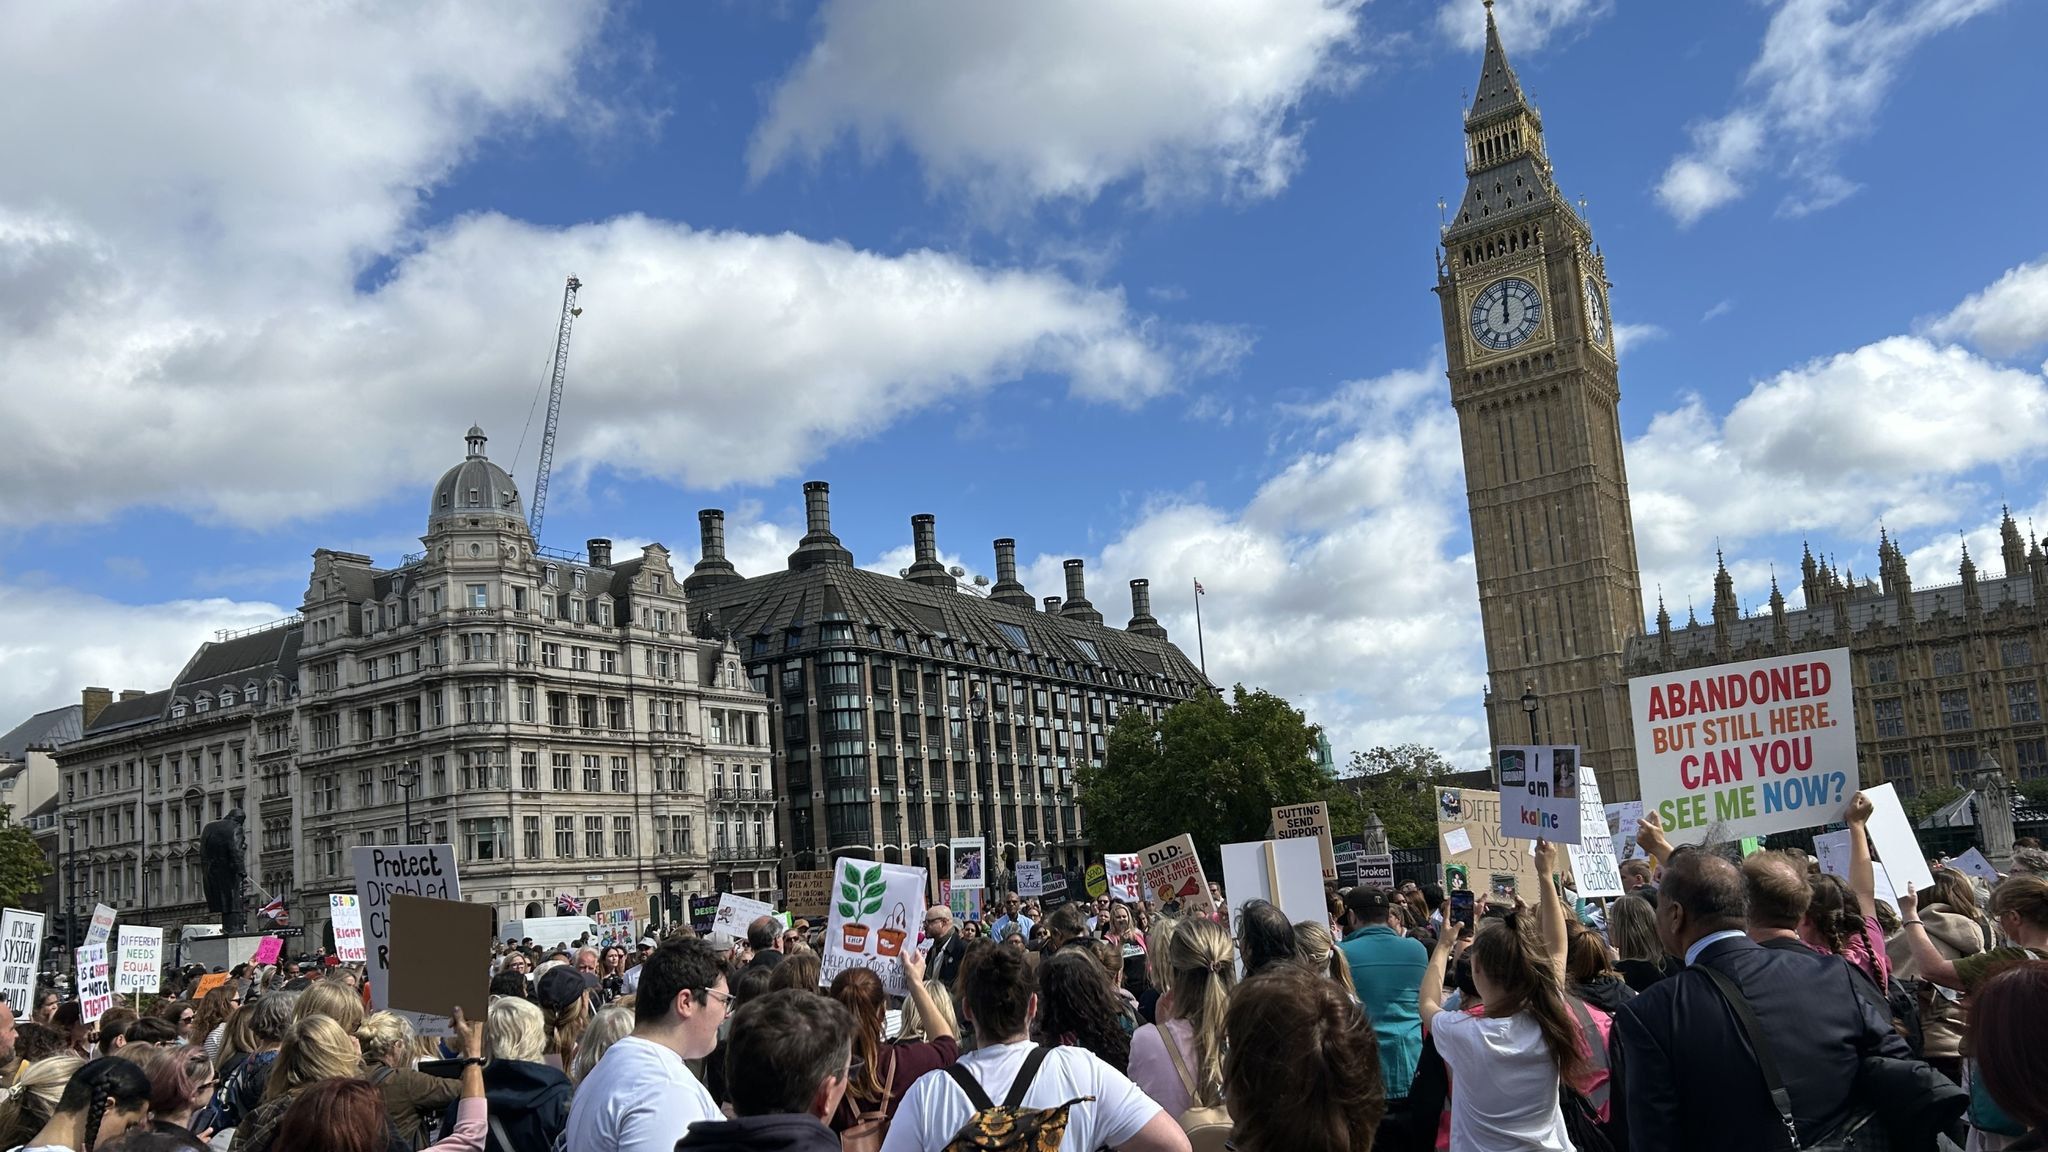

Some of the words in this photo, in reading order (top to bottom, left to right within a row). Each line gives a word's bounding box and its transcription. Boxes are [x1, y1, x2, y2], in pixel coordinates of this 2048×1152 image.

[1649, 661, 1832, 721] ABANDONED
[1652, 722, 1696, 754] BUT
[1703, 712, 1764, 745] STILL
[1770, 702, 1837, 735] HERE.
[1535, 753, 1538, 772] I
[1680, 747, 1742, 790] CAN
[1750, 736, 1813, 777] YOU
[1528, 780, 1549, 798] am
[1463, 800, 1501, 822] DIFFE
[1659, 794, 1707, 832] SEE
[1715, 786, 1756, 822] ME
[1763, 771, 1846, 814] NOW?
[1278, 805, 1320, 818] CUTTING
[1521, 805, 1558, 829] kaine
[1287, 817, 1313, 828] SEND
[1279, 826, 1324, 839] SUPPORT
[373, 849, 442, 877] Protect
[1148, 845, 1182, 865] DLD:
[1478, 849, 1524, 872] LESS!
[1592, 855, 1611, 874] SEND
[1146, 866, 1170, 880] DON'T
[1172, 856, 1196, 870] MUTE
[1149, 878, 1167, 888] OUR
[1168, 865, 1200, 882] FUTURE
[1360, 866, 1390, 877] broken
[332, 896, 356, 906] SEND
[597, 908, 633, 925] FIGHTING
[12, 920, 24, 938] IT'S
[24, 922, 35, 940] THE
[336, 928, 362, 938] RIGHT
[121, 935, 160, 946] DIFFERENT
[847, 936, 862, 944] EHCP
[3, 939, 36, 964] SYSTEM
[126, 948, 154, 959] NEEDS
[338, 946, 367, 960] FIGHT
[124, 962, 154, 972] EQUAL
[824, 954, 844, 968] HELP
[845, 956, 862, 968] OUR
[866, 960, 884, 973] KIDS
[4, 966, 18, 984] NOT
[18, 966, 30, 984] THE
[120, 974, 157, 986] RIGHTS
[822, 967, 836, 980] NOT
[84, 996, 111, 1018] FIGHT!
